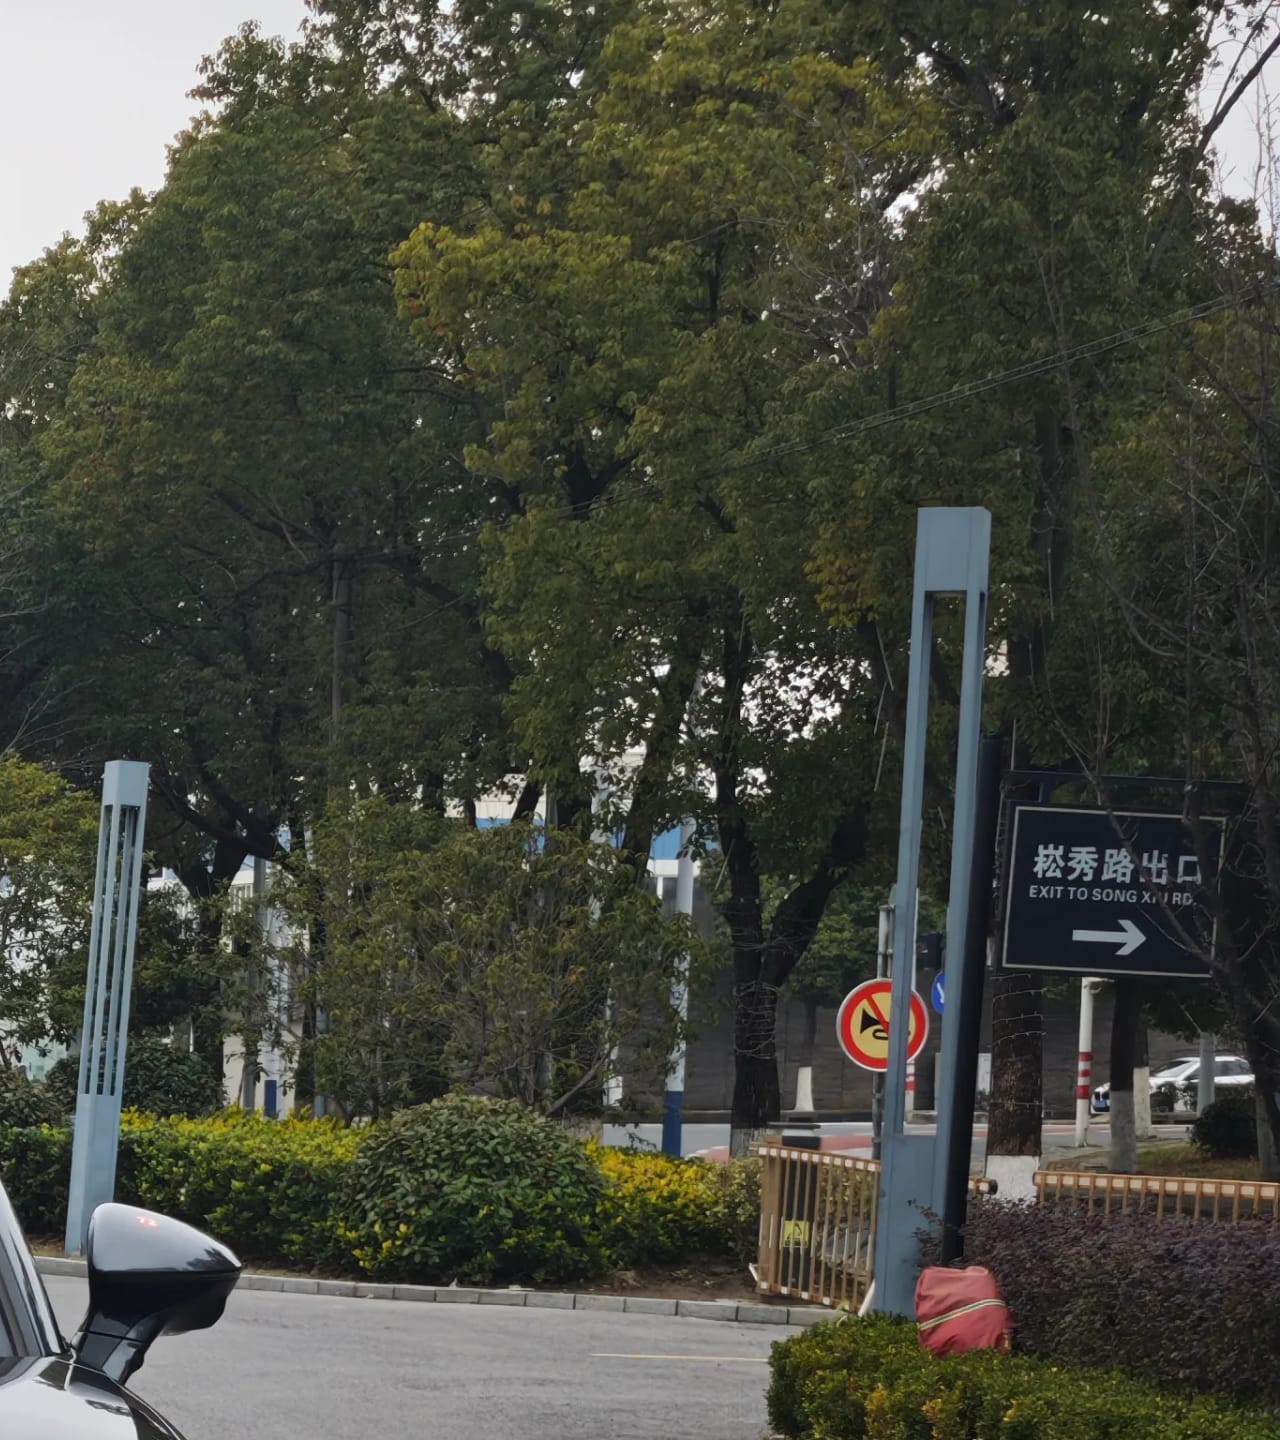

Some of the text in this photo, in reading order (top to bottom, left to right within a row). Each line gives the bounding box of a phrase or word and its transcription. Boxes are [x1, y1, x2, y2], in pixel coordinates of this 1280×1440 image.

[1029, 885, 1065, 899] EXIT
[1067, 886, 1088, 901] TO
[1091, 888, 1138, 903] SONG
